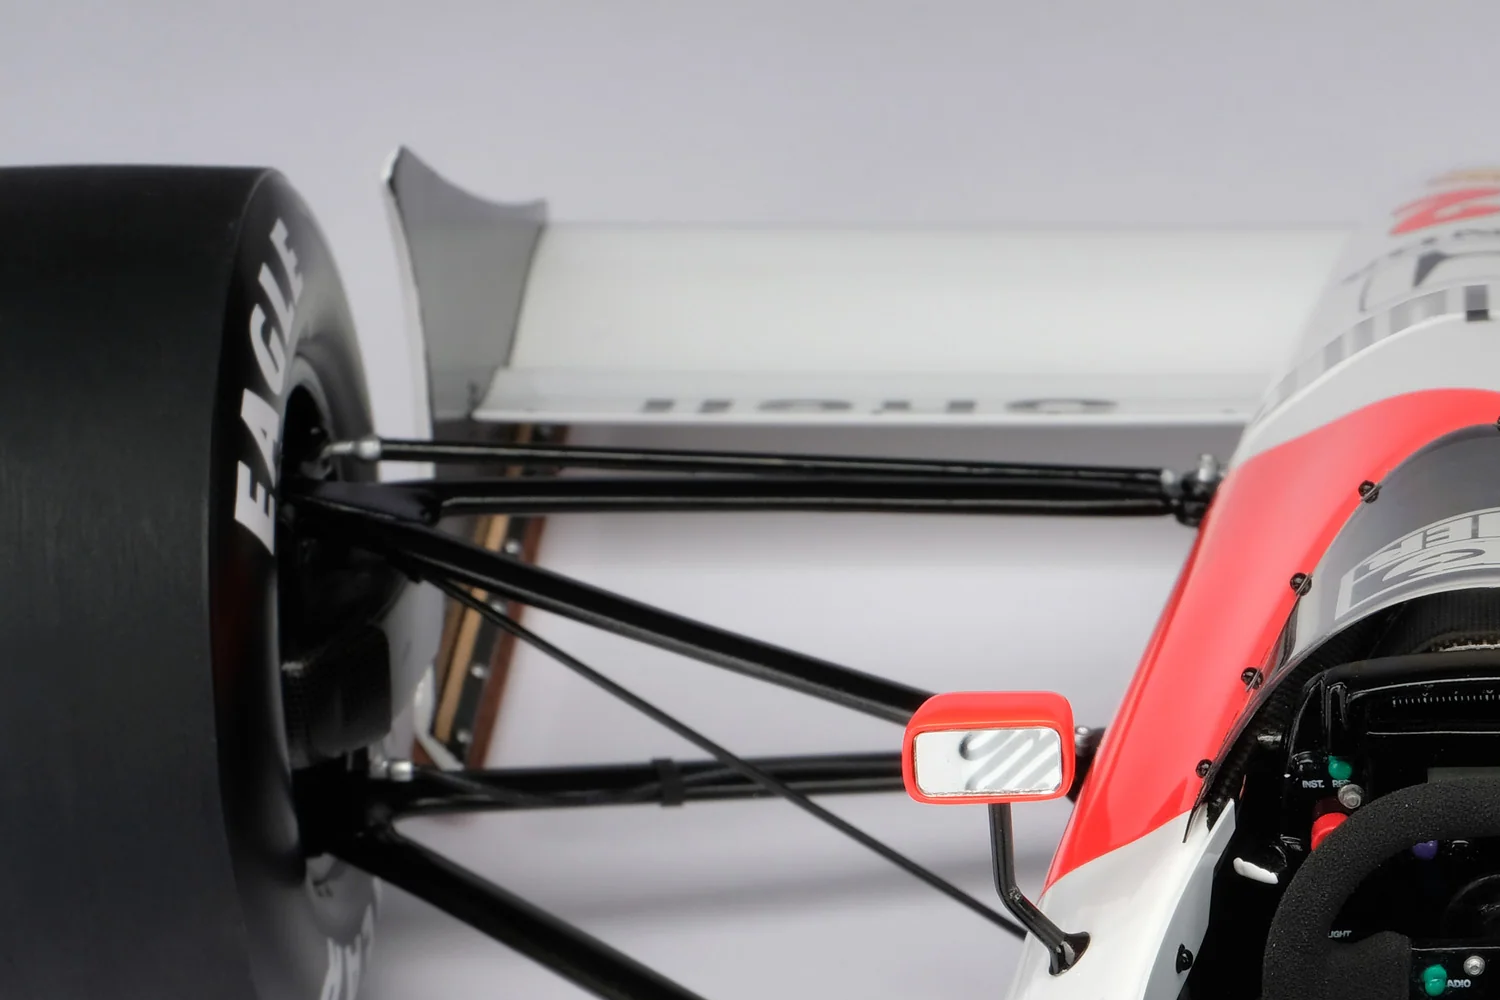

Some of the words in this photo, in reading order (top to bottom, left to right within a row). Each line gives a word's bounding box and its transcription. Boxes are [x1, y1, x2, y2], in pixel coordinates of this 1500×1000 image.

[234, 217, 303, 556] EAGLE
[1301, 779, 1325, 789] INST.
[1446, 978, 1472, 988] ADIO
